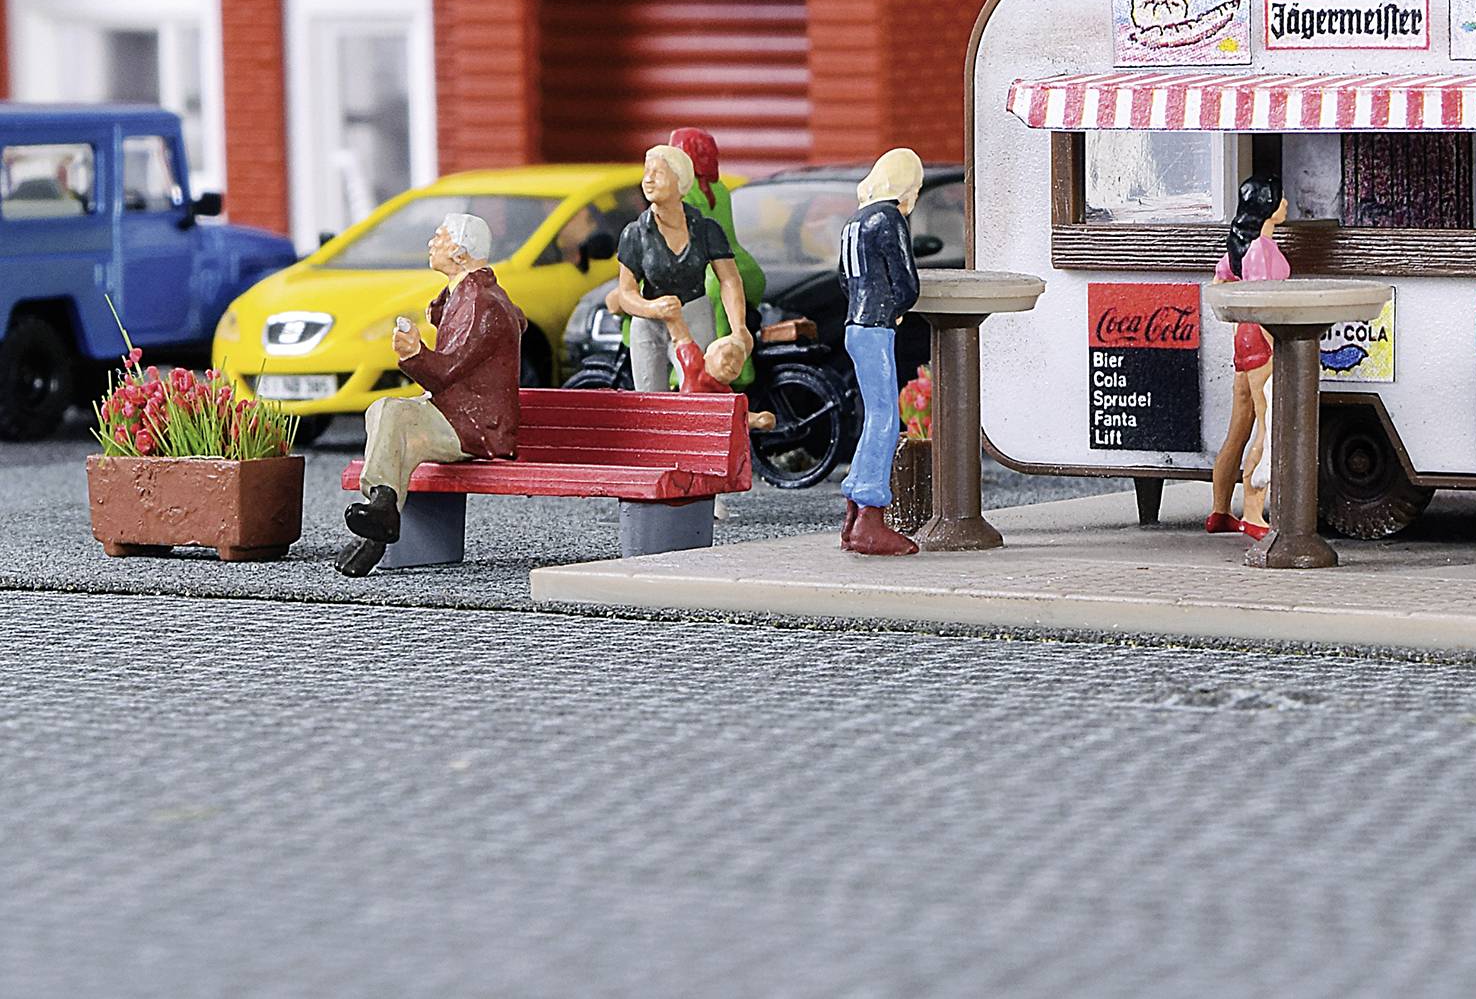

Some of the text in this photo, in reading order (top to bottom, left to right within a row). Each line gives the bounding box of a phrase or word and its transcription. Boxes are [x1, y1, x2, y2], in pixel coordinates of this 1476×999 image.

[1271, 2, 1422, 40] Jägermeister
[1093, 352, 1124, 368] Bier
[1093, 371, 1127, 387] Cola
[1094, 410, 1137, 427] Fanta
[1095, 430, 1122, 445] Lift
